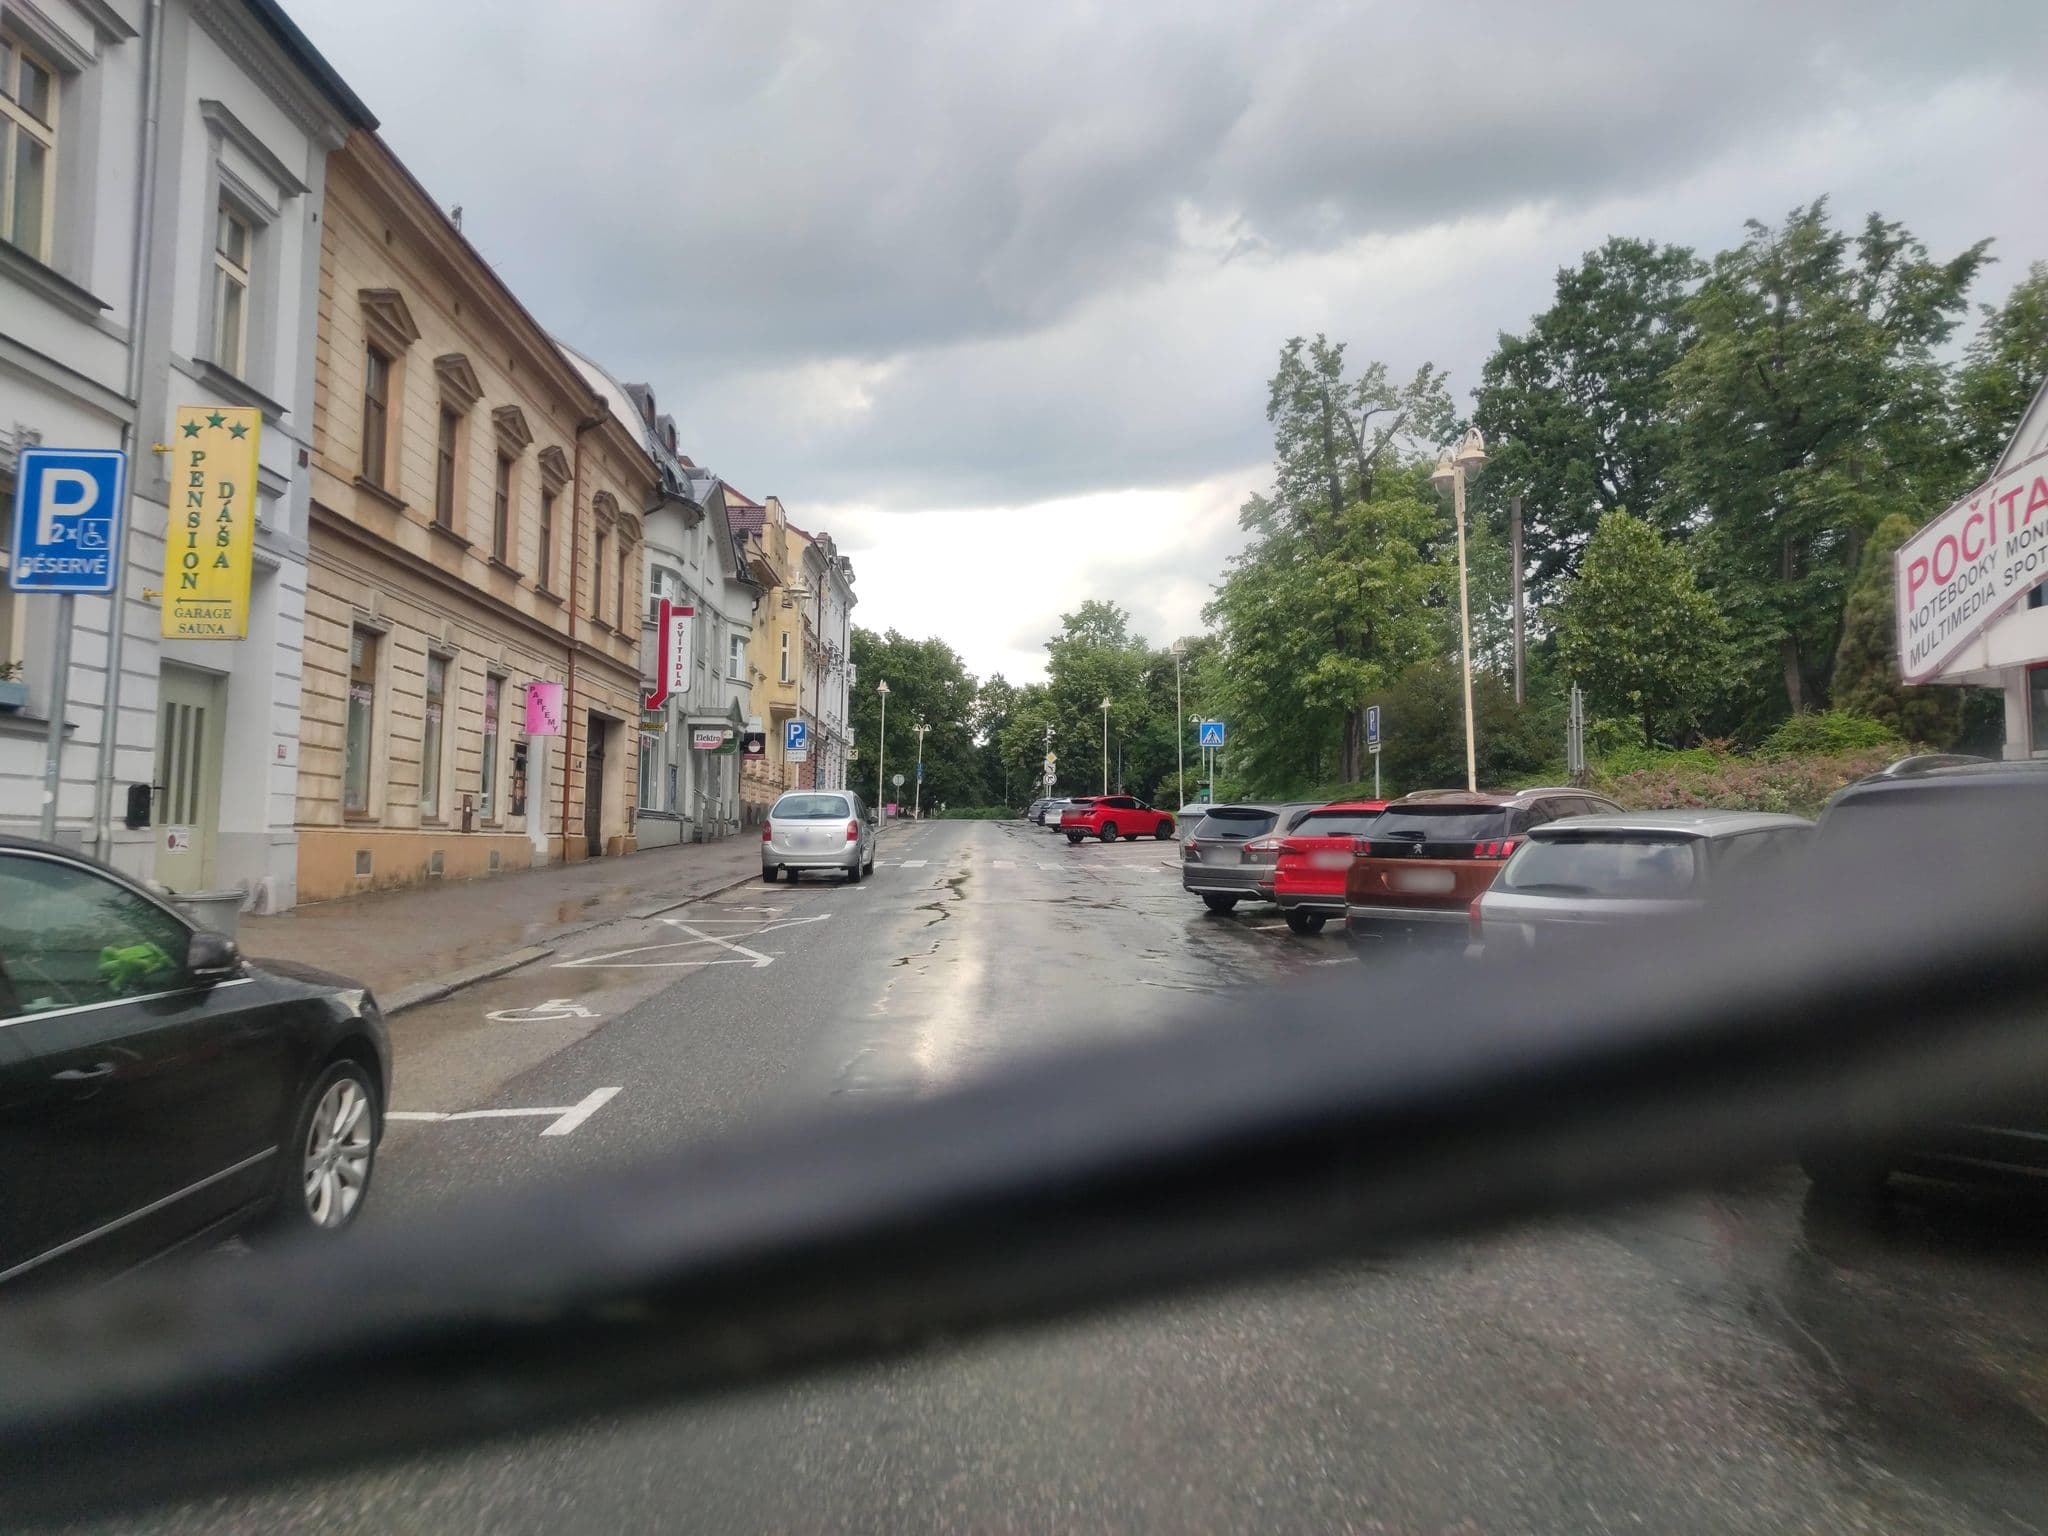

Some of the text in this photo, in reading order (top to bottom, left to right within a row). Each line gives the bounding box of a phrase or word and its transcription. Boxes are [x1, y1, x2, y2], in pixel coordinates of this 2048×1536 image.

[36, 468, 99, 545] P
[180, 450, 206, 590] PENSION
[212, 481, 235, 569] DÁŠA
[174, 607, 232, 619] GARAGE
[178, 623, 225, 634] SAUNA
[1909, 549, 1999, 639] NOTEBOOKY
[1910, 581, 1996, 668] MULTIMEDIA
[696, 733, 721, 742] Elektro
[790, 724, 802, 741] P
